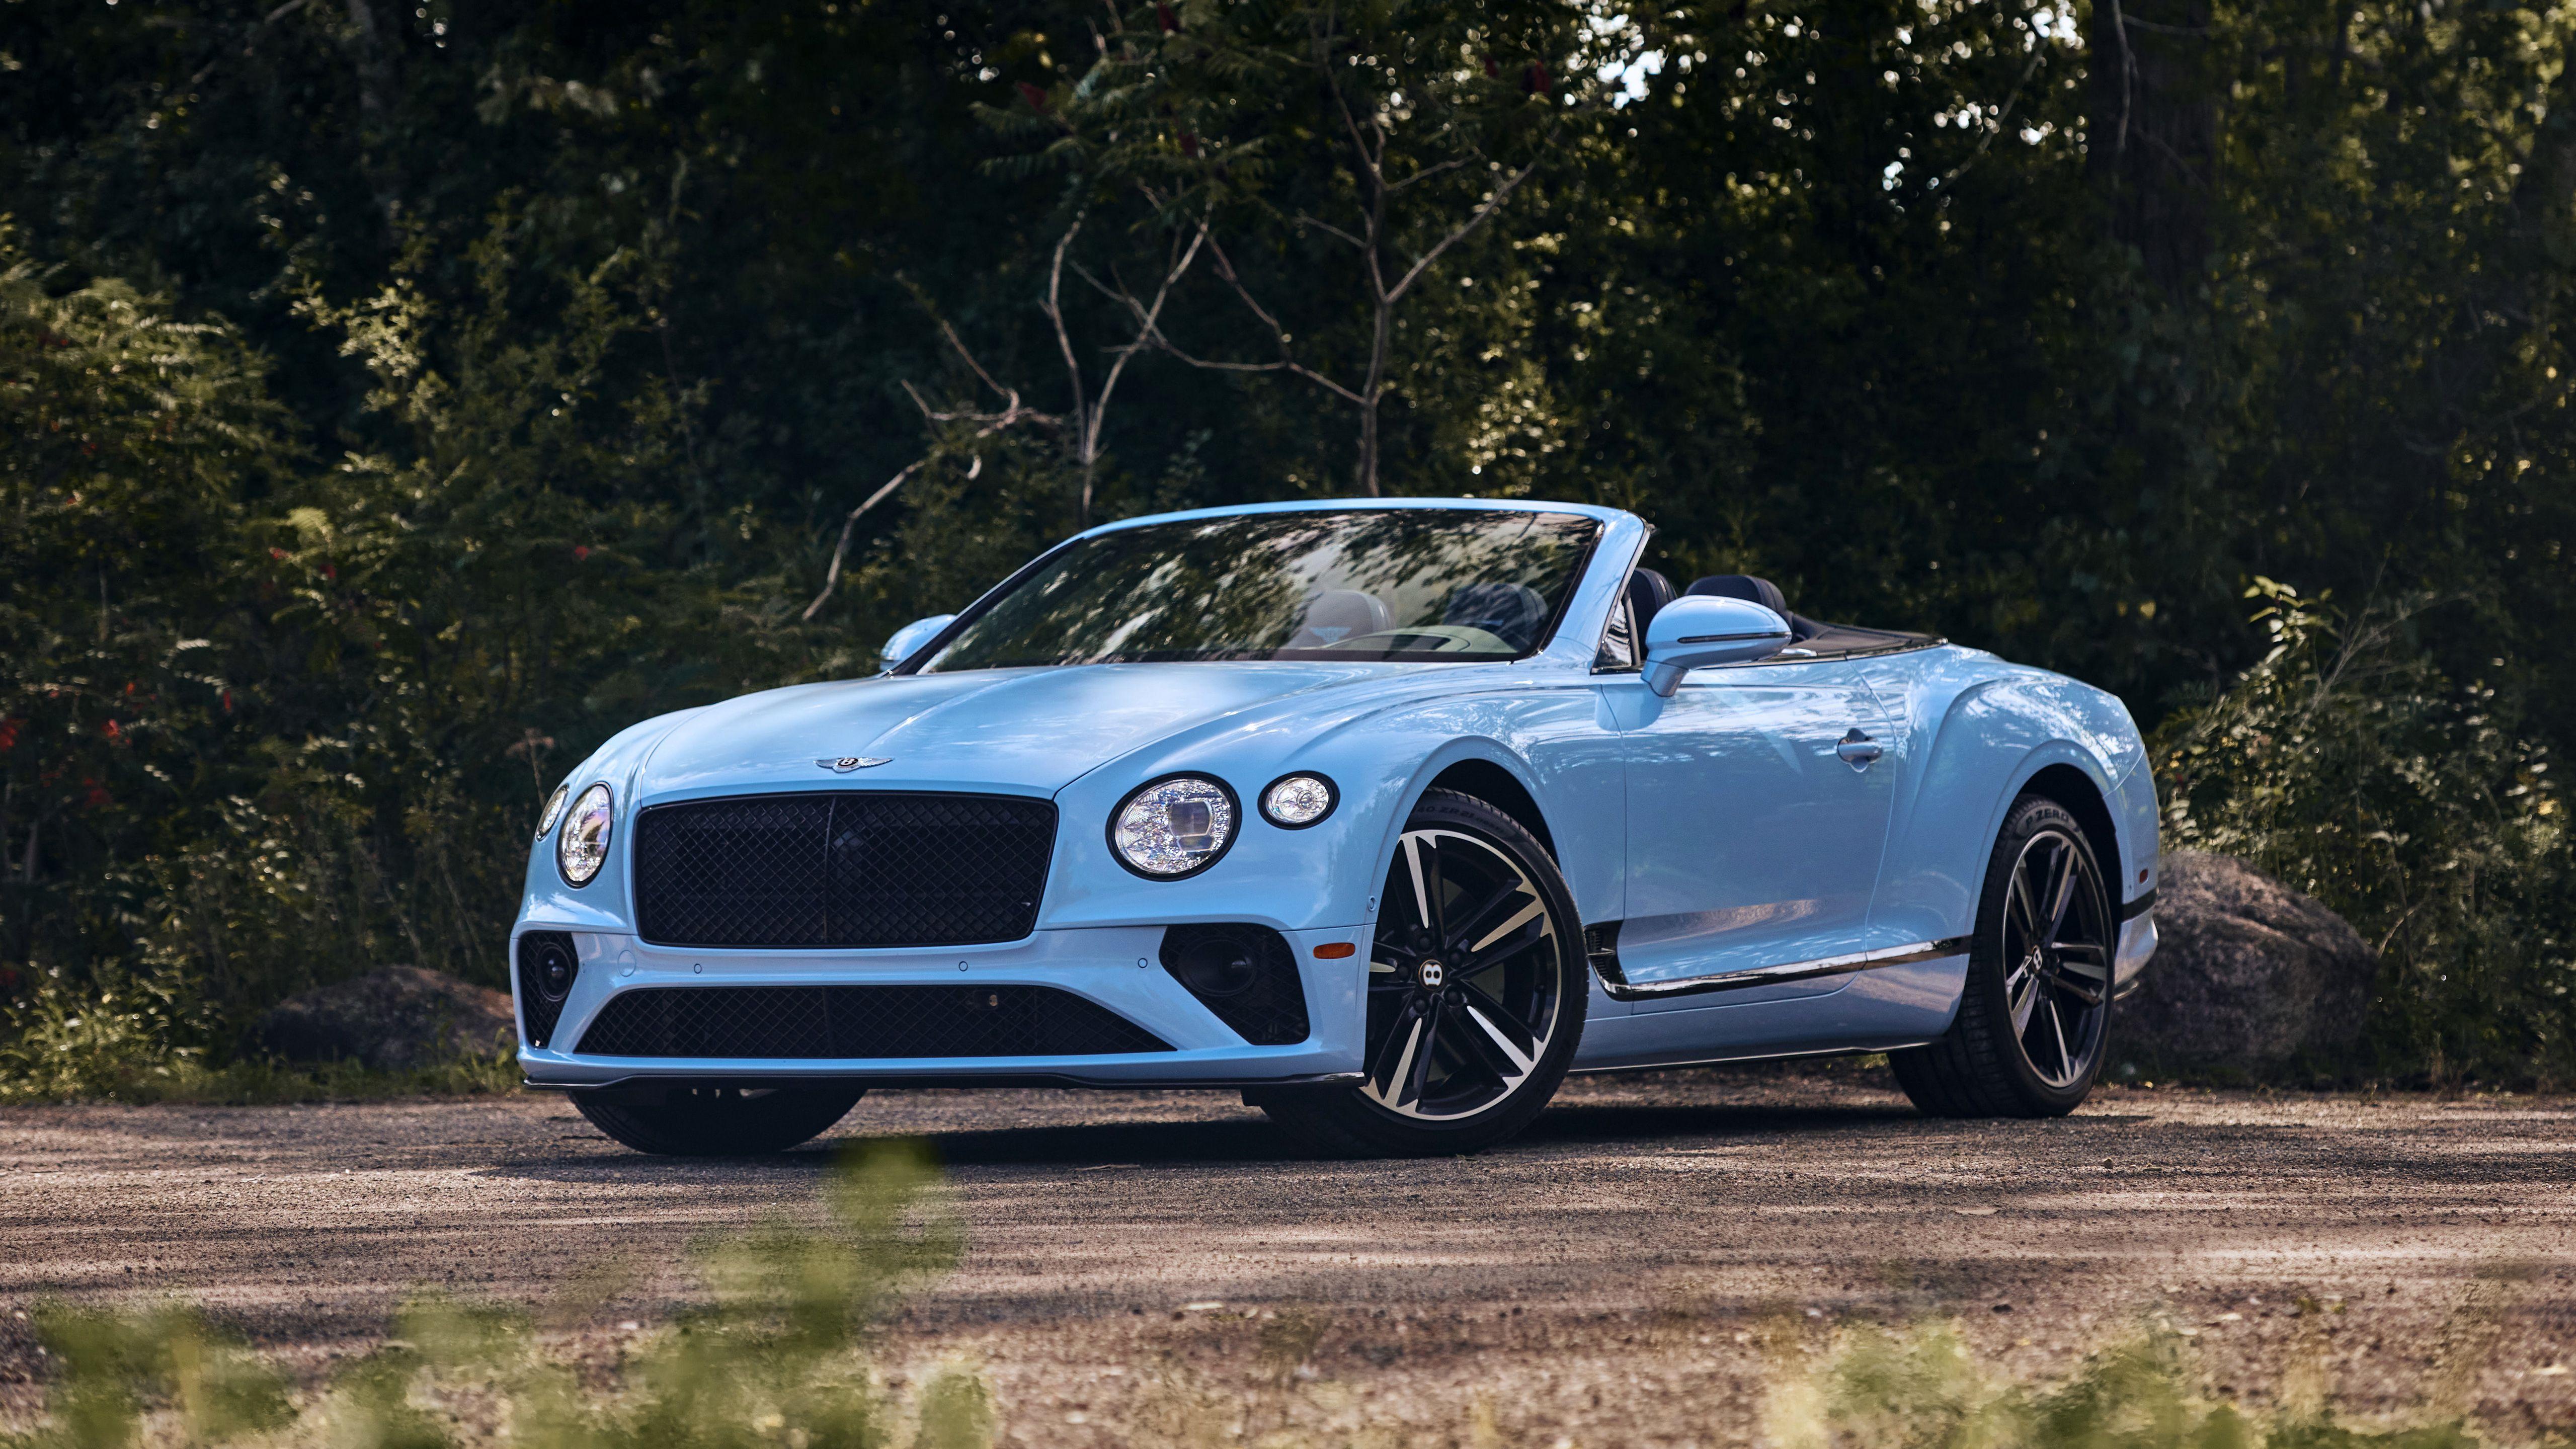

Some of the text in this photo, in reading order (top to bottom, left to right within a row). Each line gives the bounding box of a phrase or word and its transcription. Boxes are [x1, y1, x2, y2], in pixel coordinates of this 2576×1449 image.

[2026, 808, 2069, 830] P ZERO
[2033, 949, 2043, 970] B
[1423, 963, 1442, 986] B
